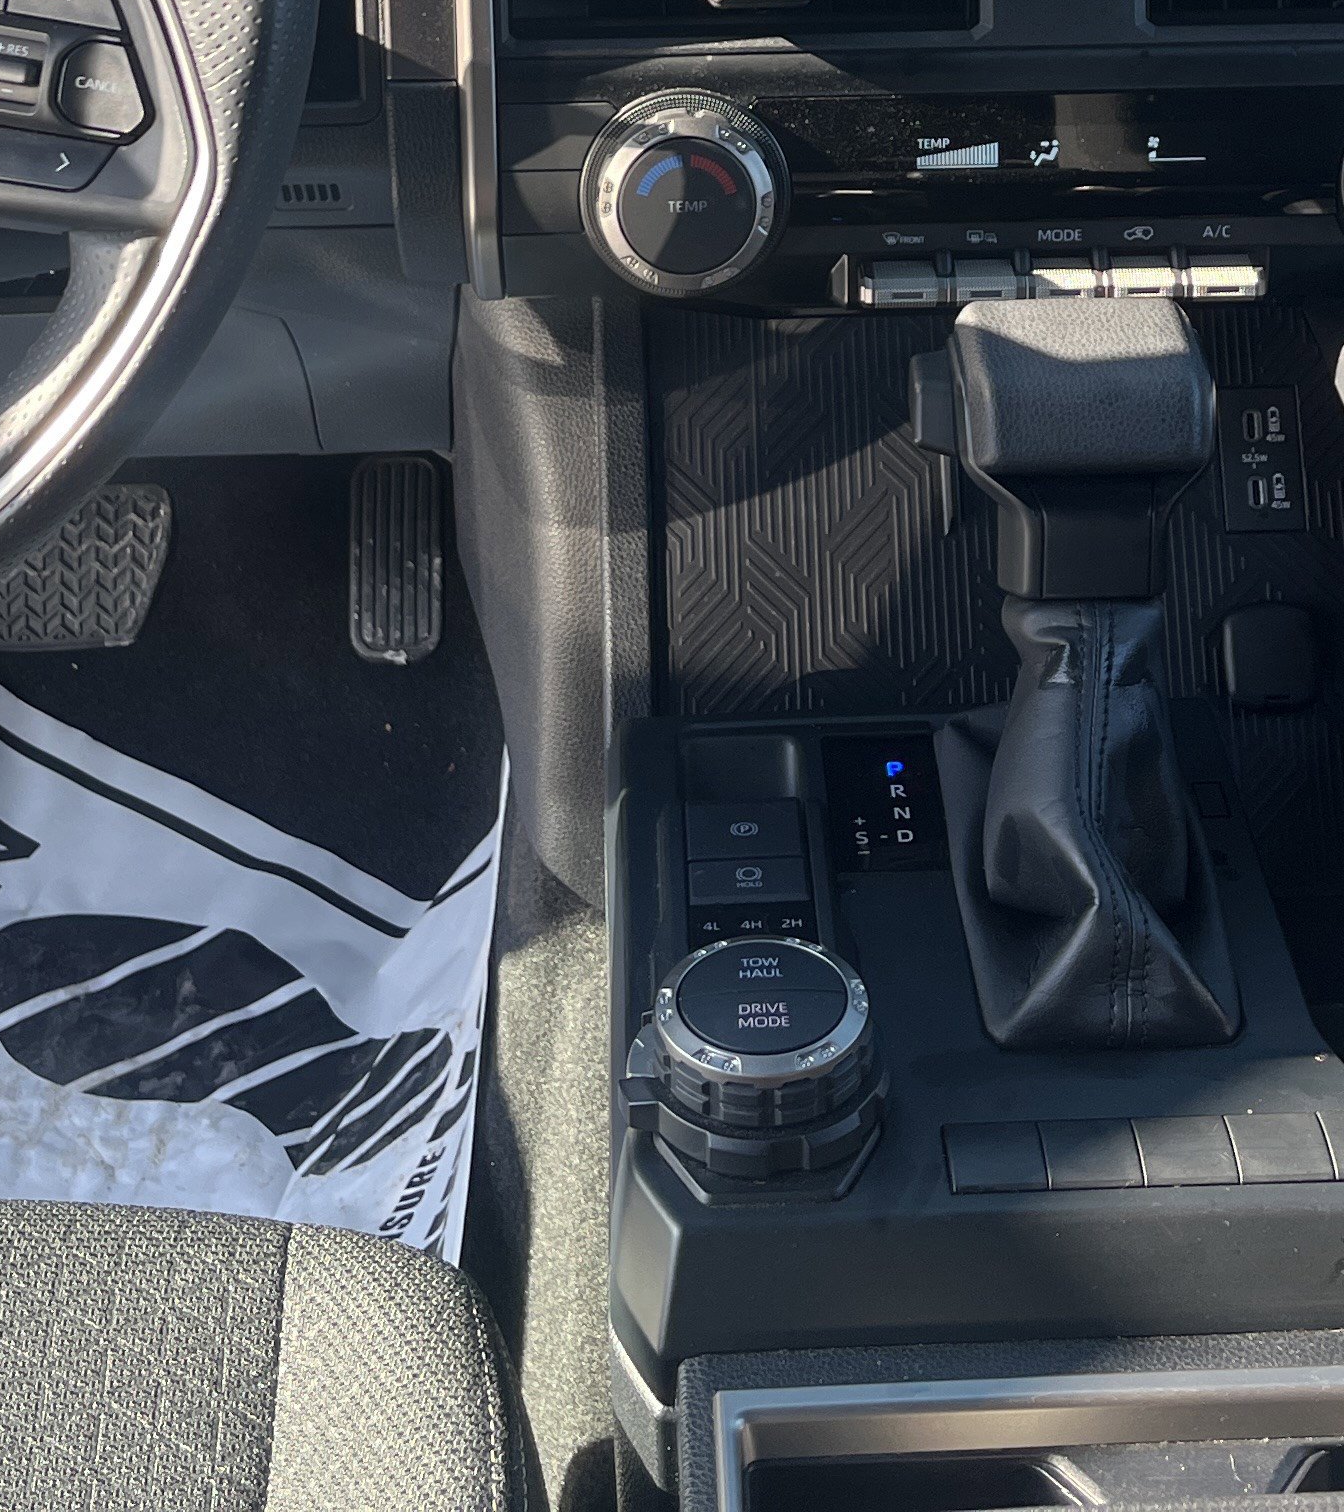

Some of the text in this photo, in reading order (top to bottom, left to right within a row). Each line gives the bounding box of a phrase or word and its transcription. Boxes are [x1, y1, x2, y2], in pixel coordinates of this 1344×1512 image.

[916, 137, 951, 150] TEMP
[667, 199, 709, 214] TEMP
[1037, 228, 1083, 242] MODE
[1202, 224, 1232, 239] A/C
[899, 235, 926, 245] FRONT
[886, 761, 905, 777] P
[889, 783, 907, 798] R
[893, 806, 911, 820] N
[854, 829, 915, 845] S D
[735, 880, 764, 889] HOLD
[702, 917, 804, 932] 4L 4H 2H
[739, 957, 779, 968] TOW
[738, 967, 784, 979] HAUL
[737, 1002, 788, 1015] DRIVE
[737, 1015, 791, 1029] MODE
[379, 1145, 447, 1240] SURE
